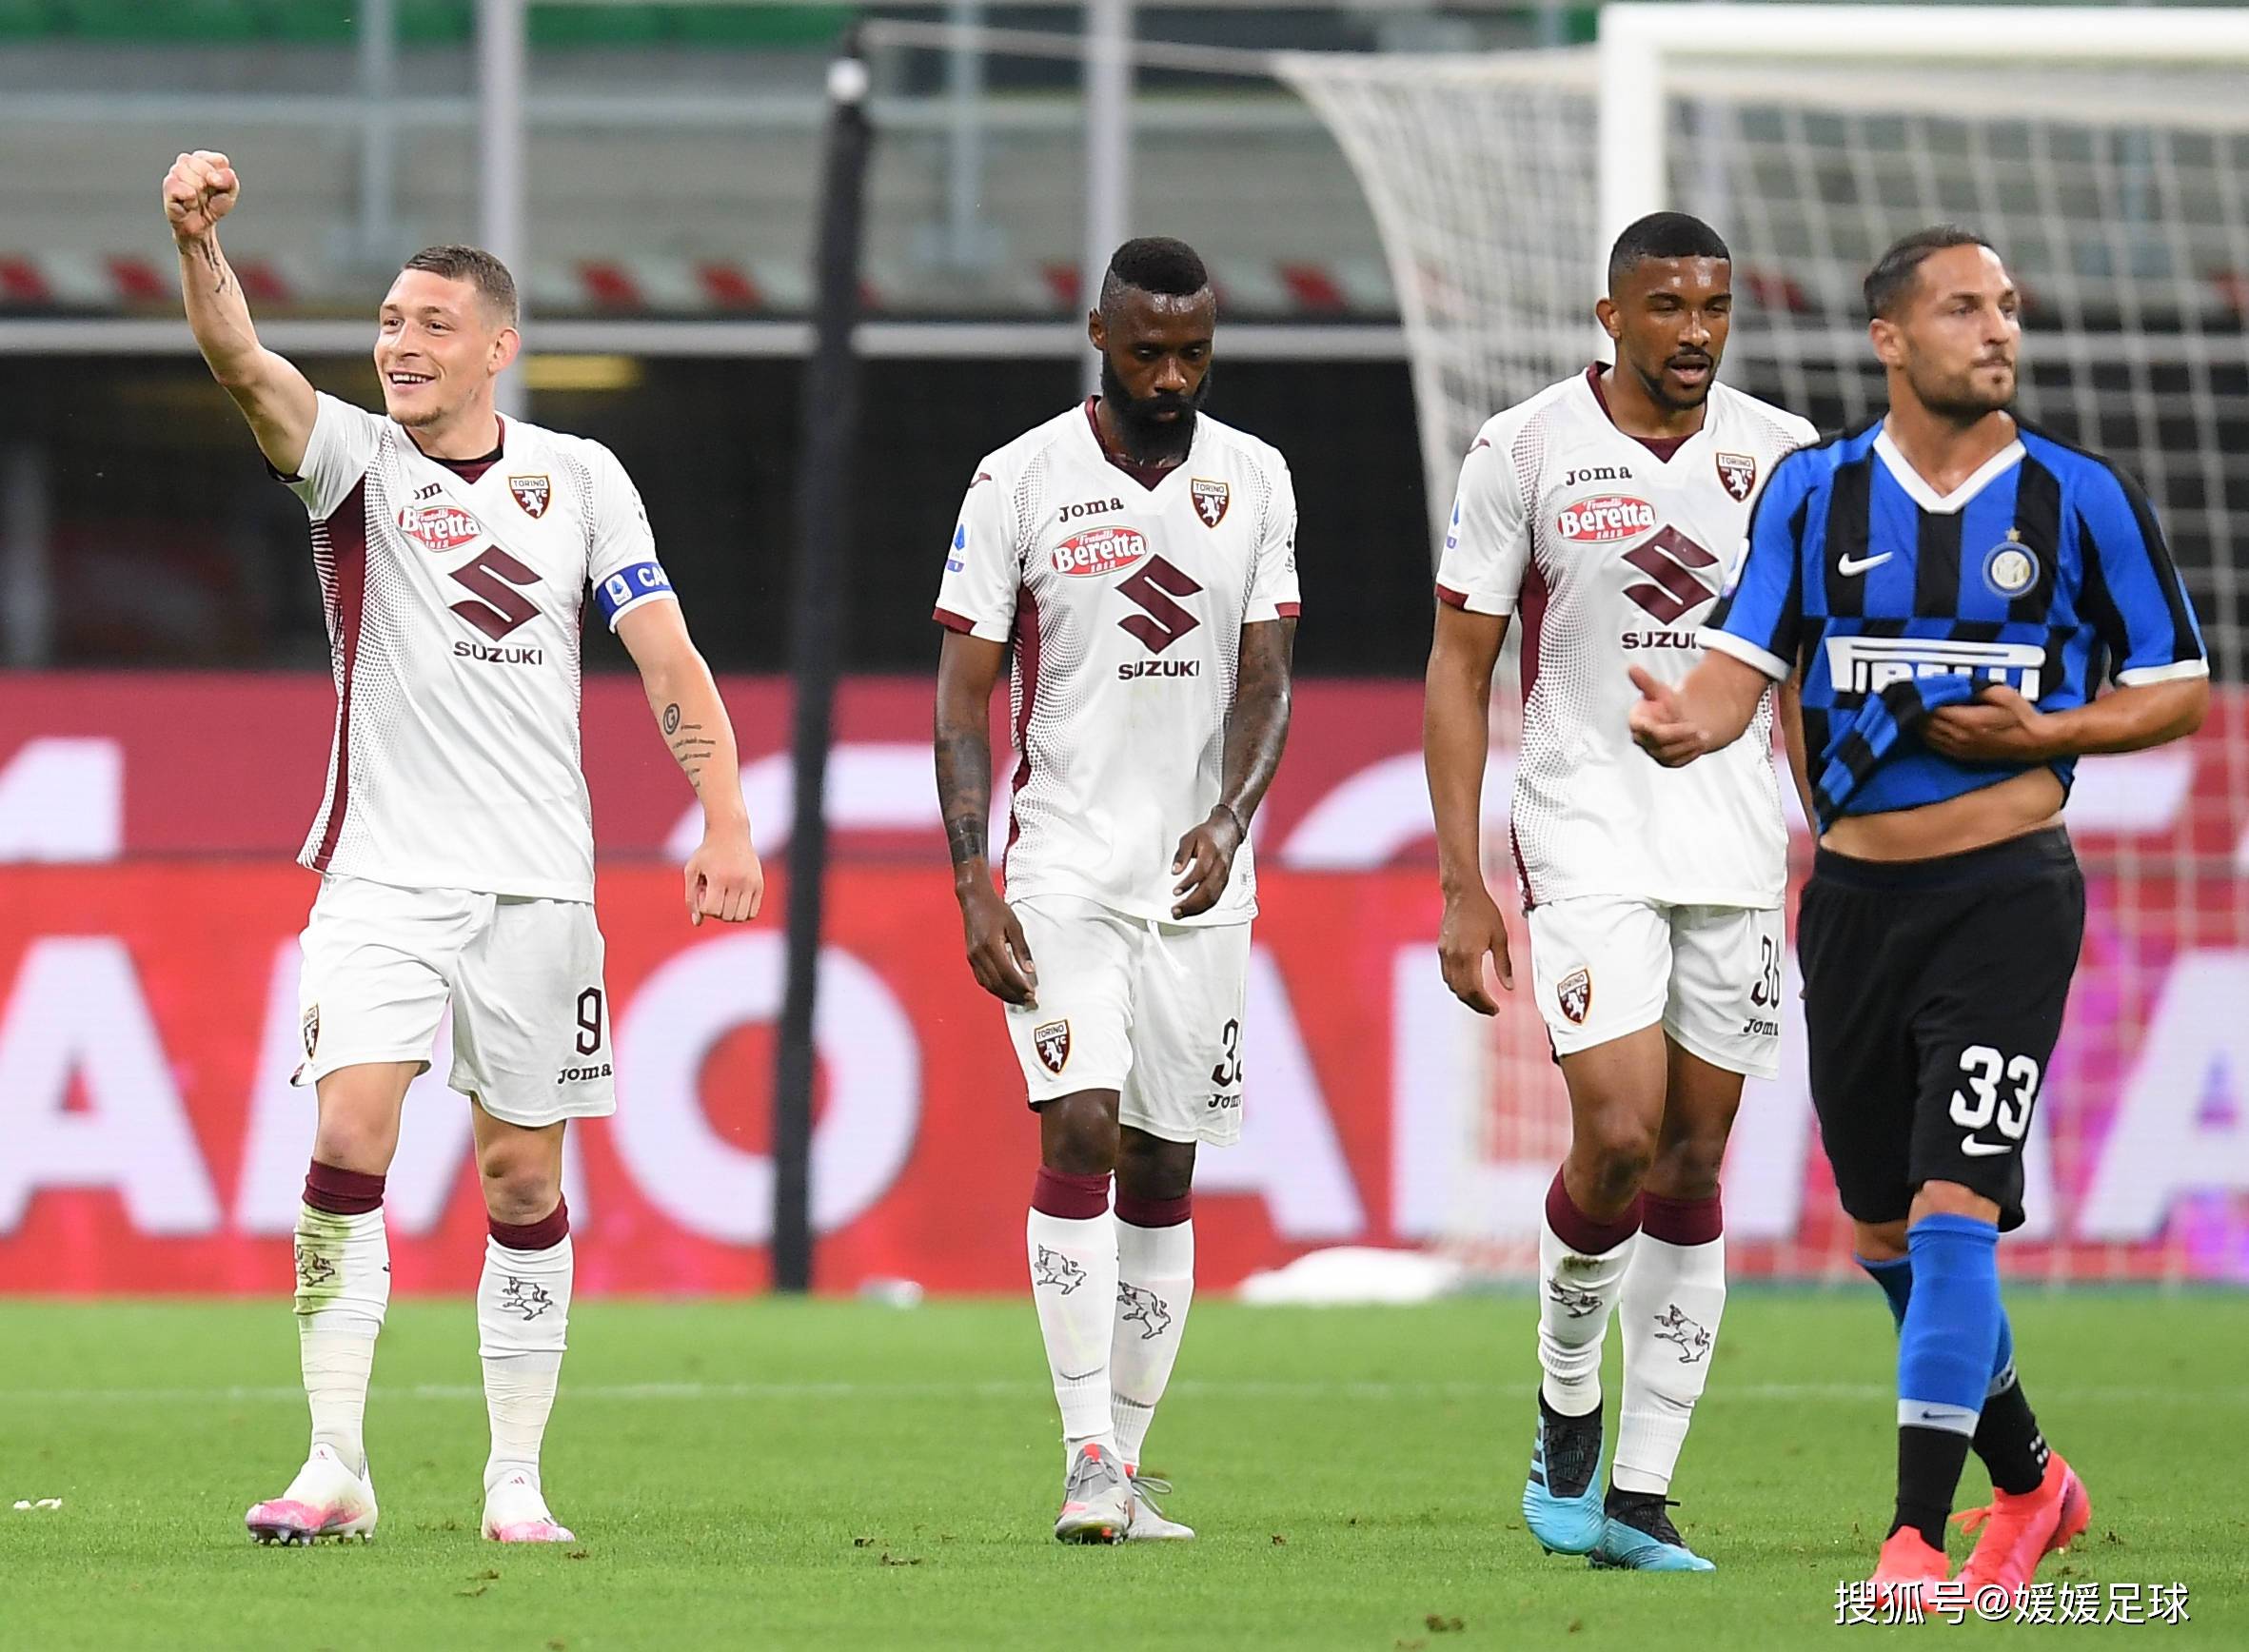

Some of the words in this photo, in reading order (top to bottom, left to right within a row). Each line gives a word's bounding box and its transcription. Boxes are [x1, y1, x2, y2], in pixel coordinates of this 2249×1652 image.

[513, 479, 545, 487] TORINO
[1566, 465, 1633, 486] Joma
[1195, 482, 1225, 494] TORINO
[1058, 498, 1124, 523] Joma
[1561, 502, 1654, 538] Beretta
[401, 506, 482, 541] Bretta
[1054, 533, 1146, 573] Beretta
[1621, 631, 1697, 649] SUZU
[453, 640, 543, 665] SUZUKI
[1117, 659, 1200, 680] SUZUKI
[576, 986, 602, 1056] 9
[1037, 1024, 1064, 1039] TORINO
[558, 1063, 612, 1084] Joma
[1949, 1045, 2039, 1140] 33
